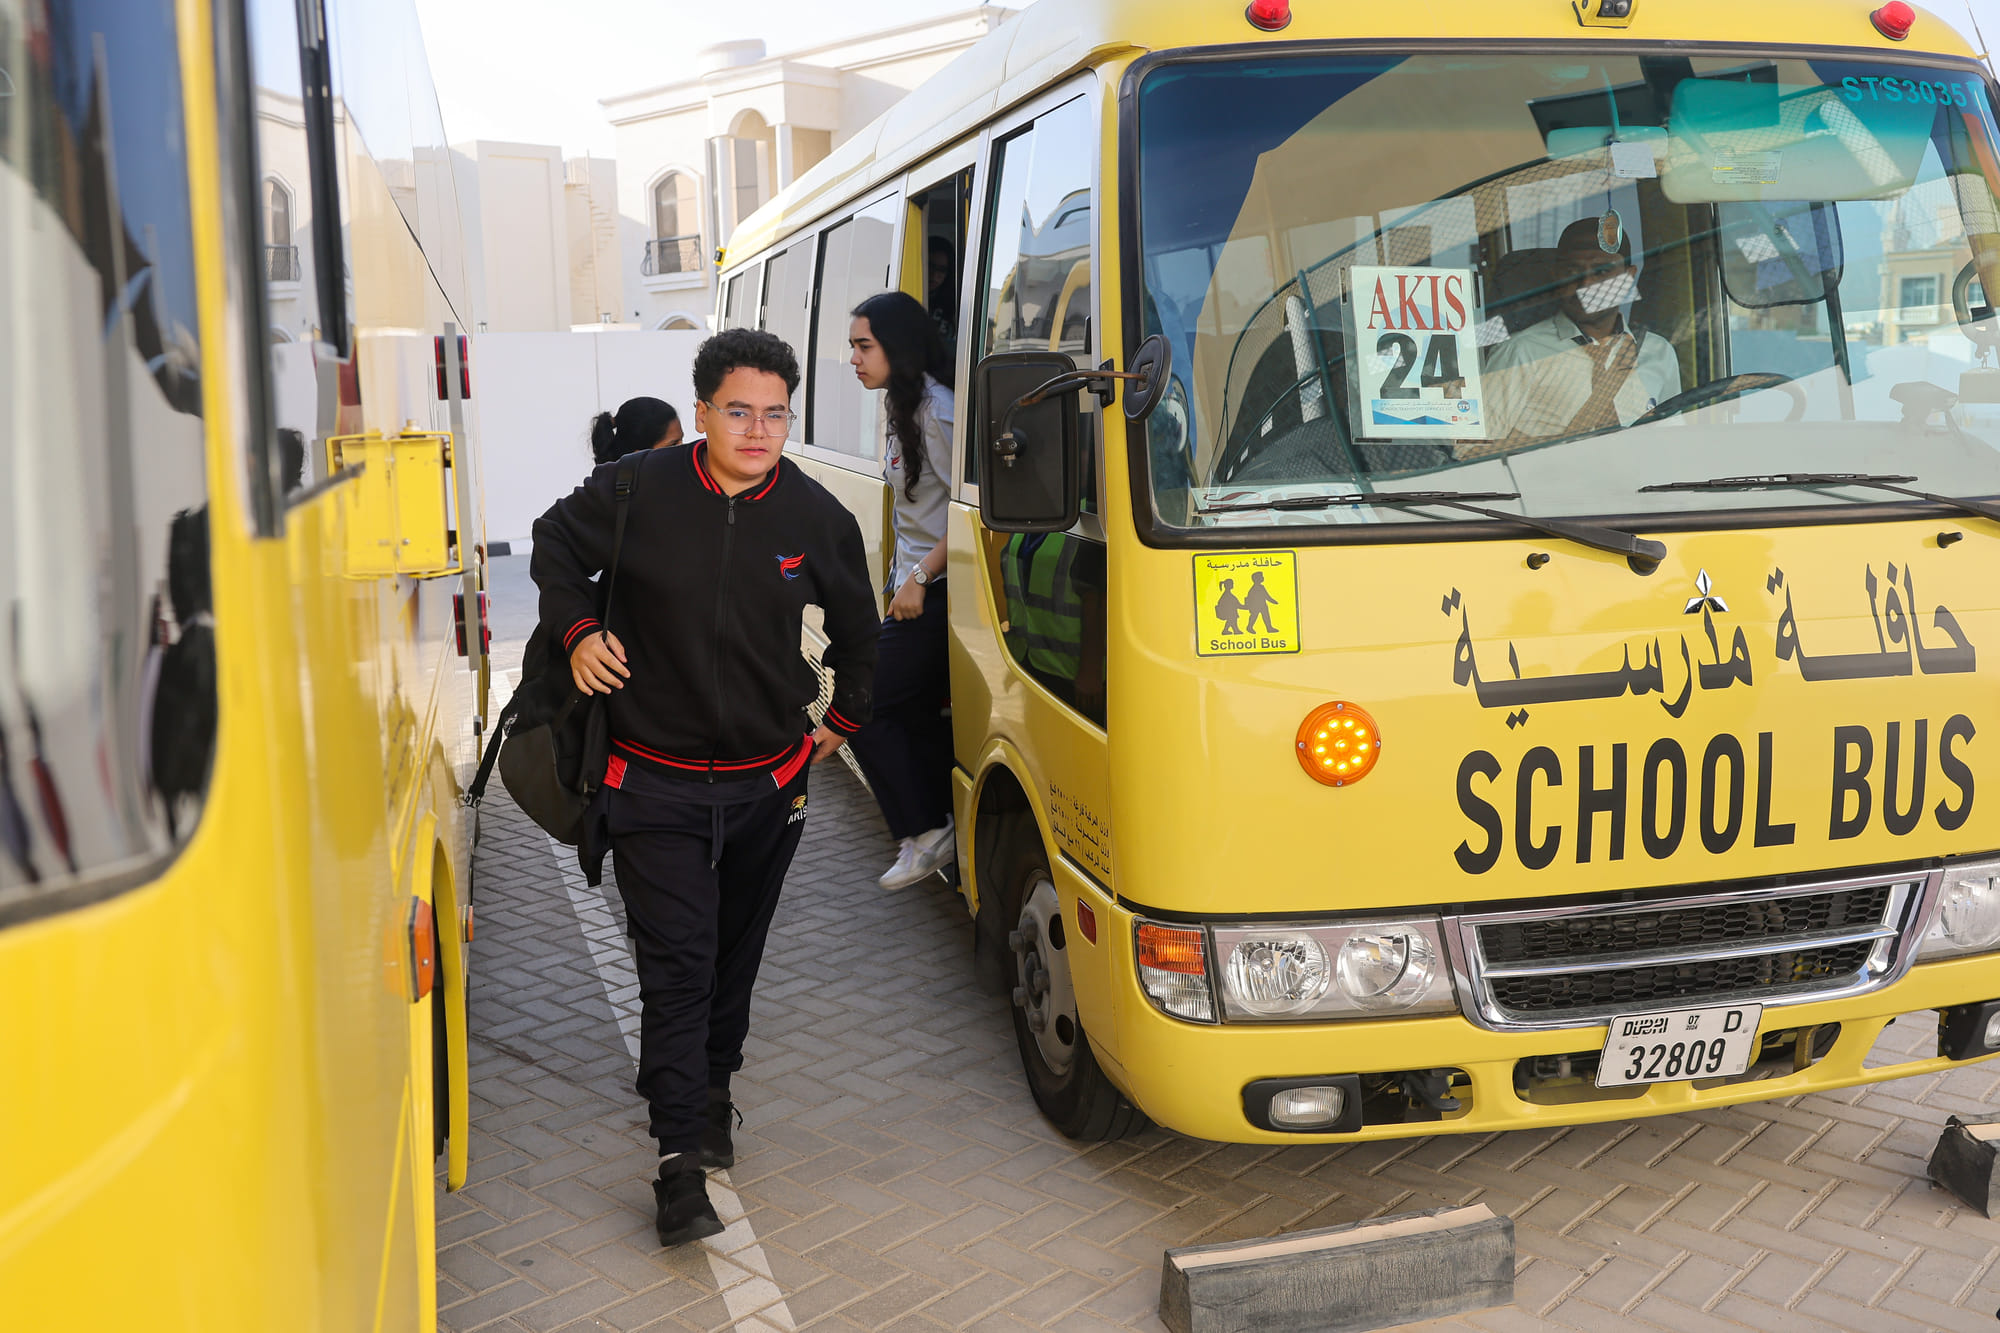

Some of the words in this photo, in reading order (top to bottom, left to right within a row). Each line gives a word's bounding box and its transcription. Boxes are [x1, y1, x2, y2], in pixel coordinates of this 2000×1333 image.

[1367, 274, 1466, 331] AKIS
[1376, 332, 1466, 399] 24
[1206, 559, 1250, 572] مدرسية
[1252, 556, 1283, 568] حافلة
[1210, 638, 1257, 651] School
[1261, 638, 1287, 649] Bus
[1766, 561, 1976, 682] حافلة
[1441, 586, 1753, 730] مدرسية
[1453, 731, 1796, 875] SCHOOL
[1828, 713, 1977, 841] BUS
[1622, 1017, 1668, 1037] DUBAI
[1688, 1015, 1700, 1025] 07
[1723, 1010, 1743, 1033] D
[1625, 1038, 1726, 1080] 32809
